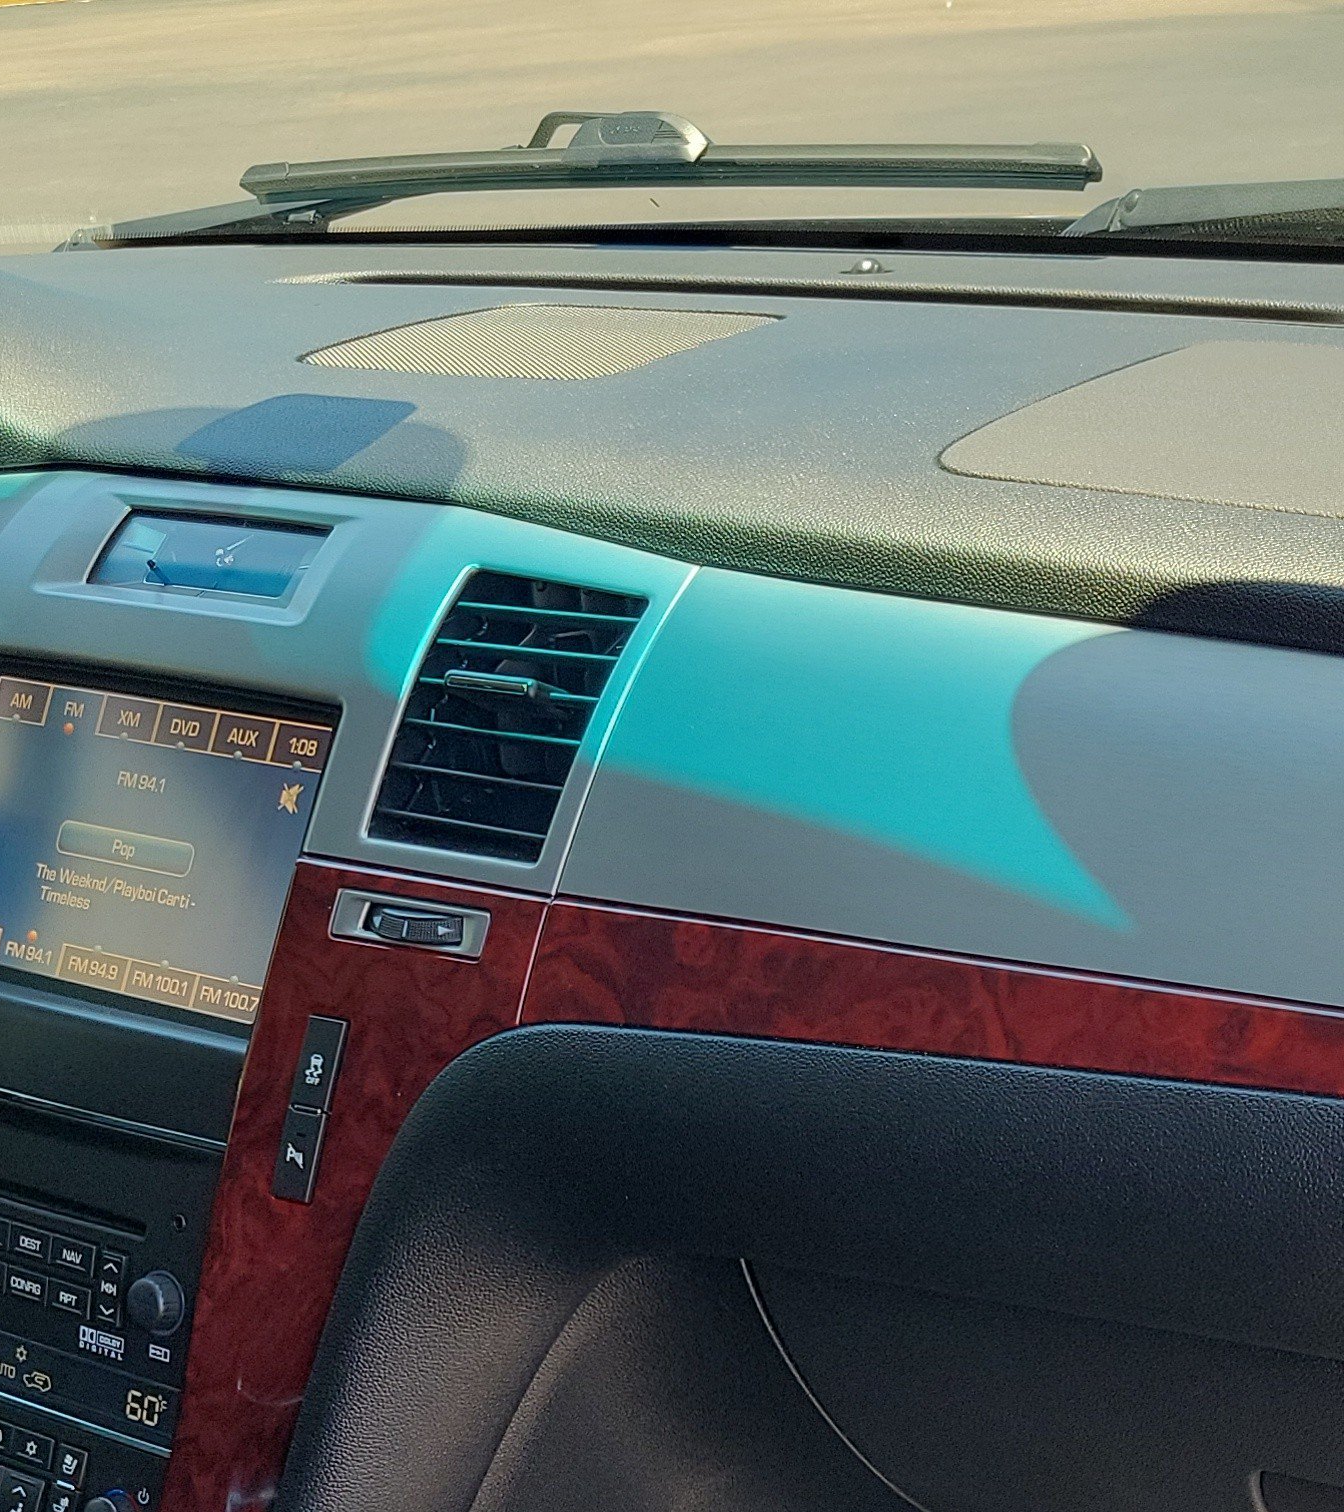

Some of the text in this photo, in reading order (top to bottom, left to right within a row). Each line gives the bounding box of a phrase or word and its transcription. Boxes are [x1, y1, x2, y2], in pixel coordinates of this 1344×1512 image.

[10, 692, 34, 709] AM
[63, 701, 85, 718] FM
[117, 709, 141, 727] XM
[169, 717, 200, 737] DVD
[227, 727, 259, 748] AUX
[288, 736, 318, 757] 1:08
[117, 770, 166, 793] FM 94.1
[111, 838, 135, 860] Pop
[36, 862, 57, 882] The
[40, 885, 91, 910] Timeless
[5, 941, 53, 965] FM 94.1
[68, 956, 118, 980] FM 94.9
[132, 971, 188, 997] FM 100.1
[199, 985, 260, 1012] FM 100.7
[19, 1235, 42, 1251] DEST
[62, 1248, 83, 1264] NAV
[59, 1291, 77, 1307] RPT
[79, 1340, 123, 1361] DIGITAL
